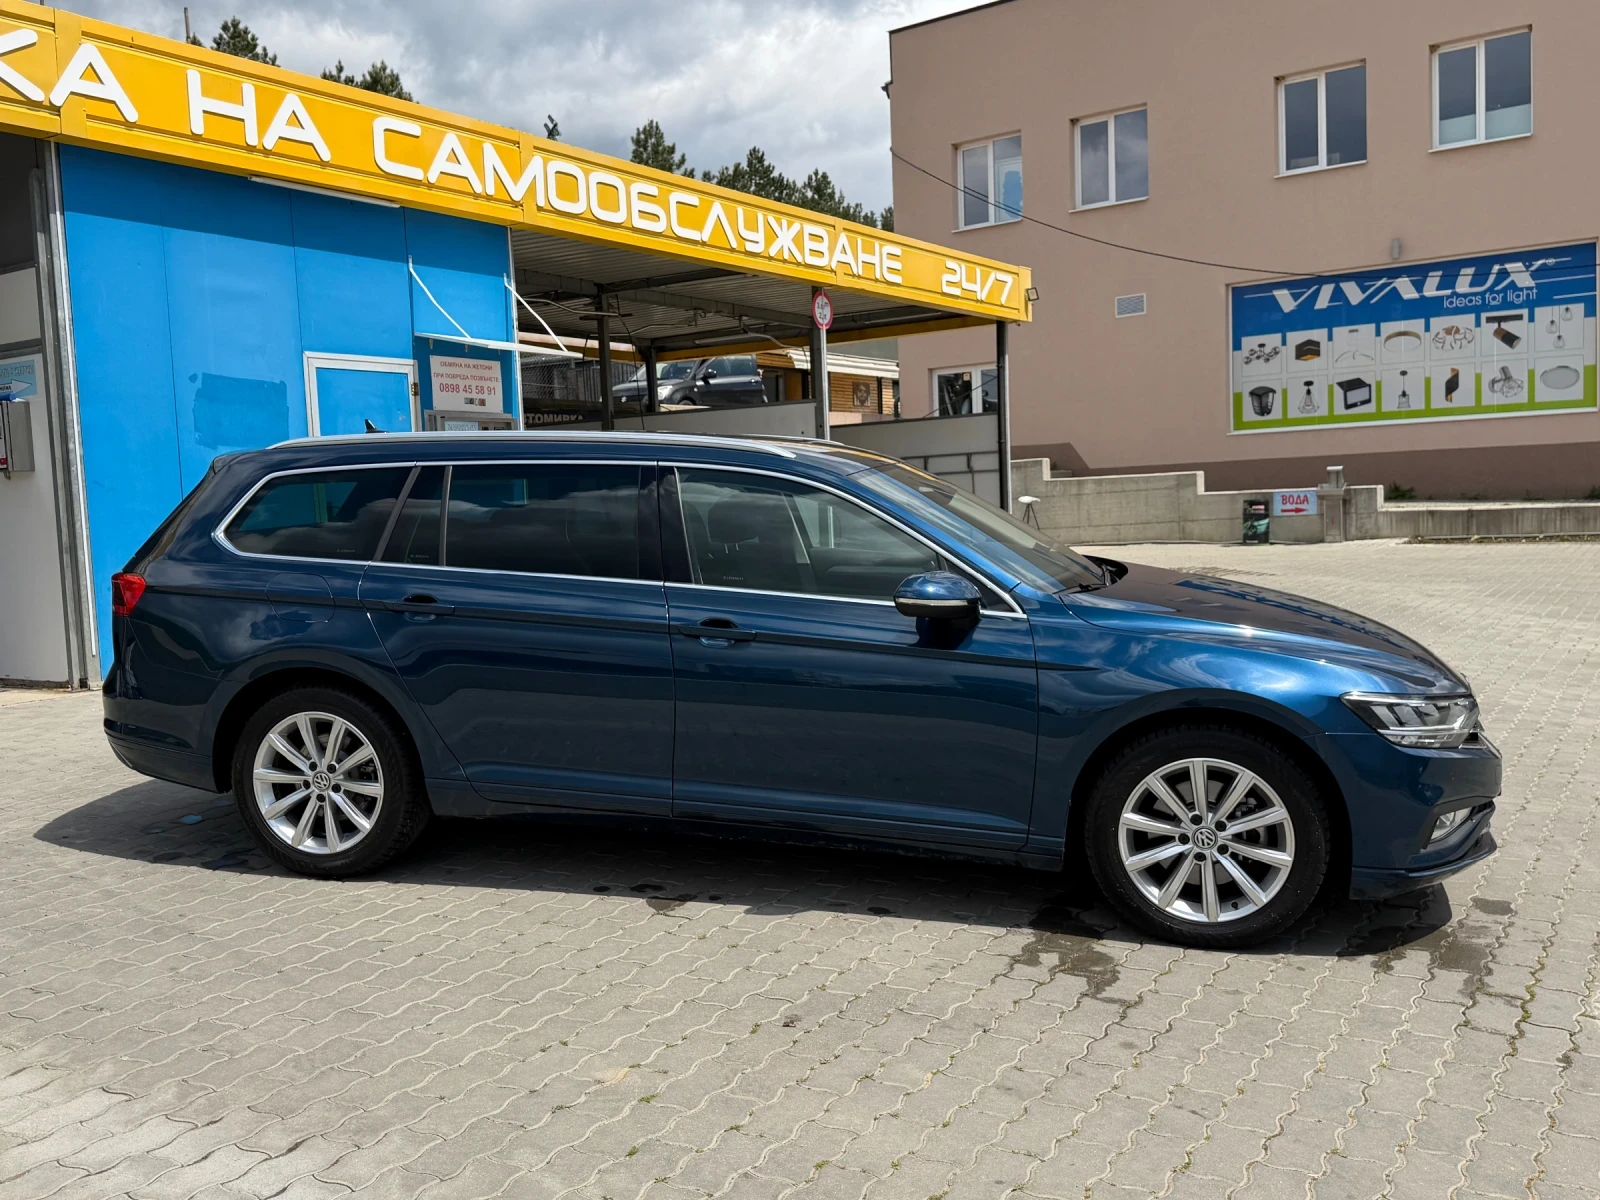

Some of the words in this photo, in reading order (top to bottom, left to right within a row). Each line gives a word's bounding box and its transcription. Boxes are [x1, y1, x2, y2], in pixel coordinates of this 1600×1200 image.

[186, 69, 331, 163] НА
[373, 116, 902, 284] САМООБСЛУЖВАНЕ
[941, 260, 1013, 307] 24/7
[1272, 261, 1545, 313] VIVALUX
[1443, 292, 1482, 309] ideas
[1485, 290, 1504, 307] for
[1507, 287, 1538, 303] light
[439, 383, 460, 393] 0898
[462, 384, 473, 394] 45
[475, 385, 485, 395] 58
[487, 386, 496, 396] 91
[1281, 494, 1309, 505] ВОДА
